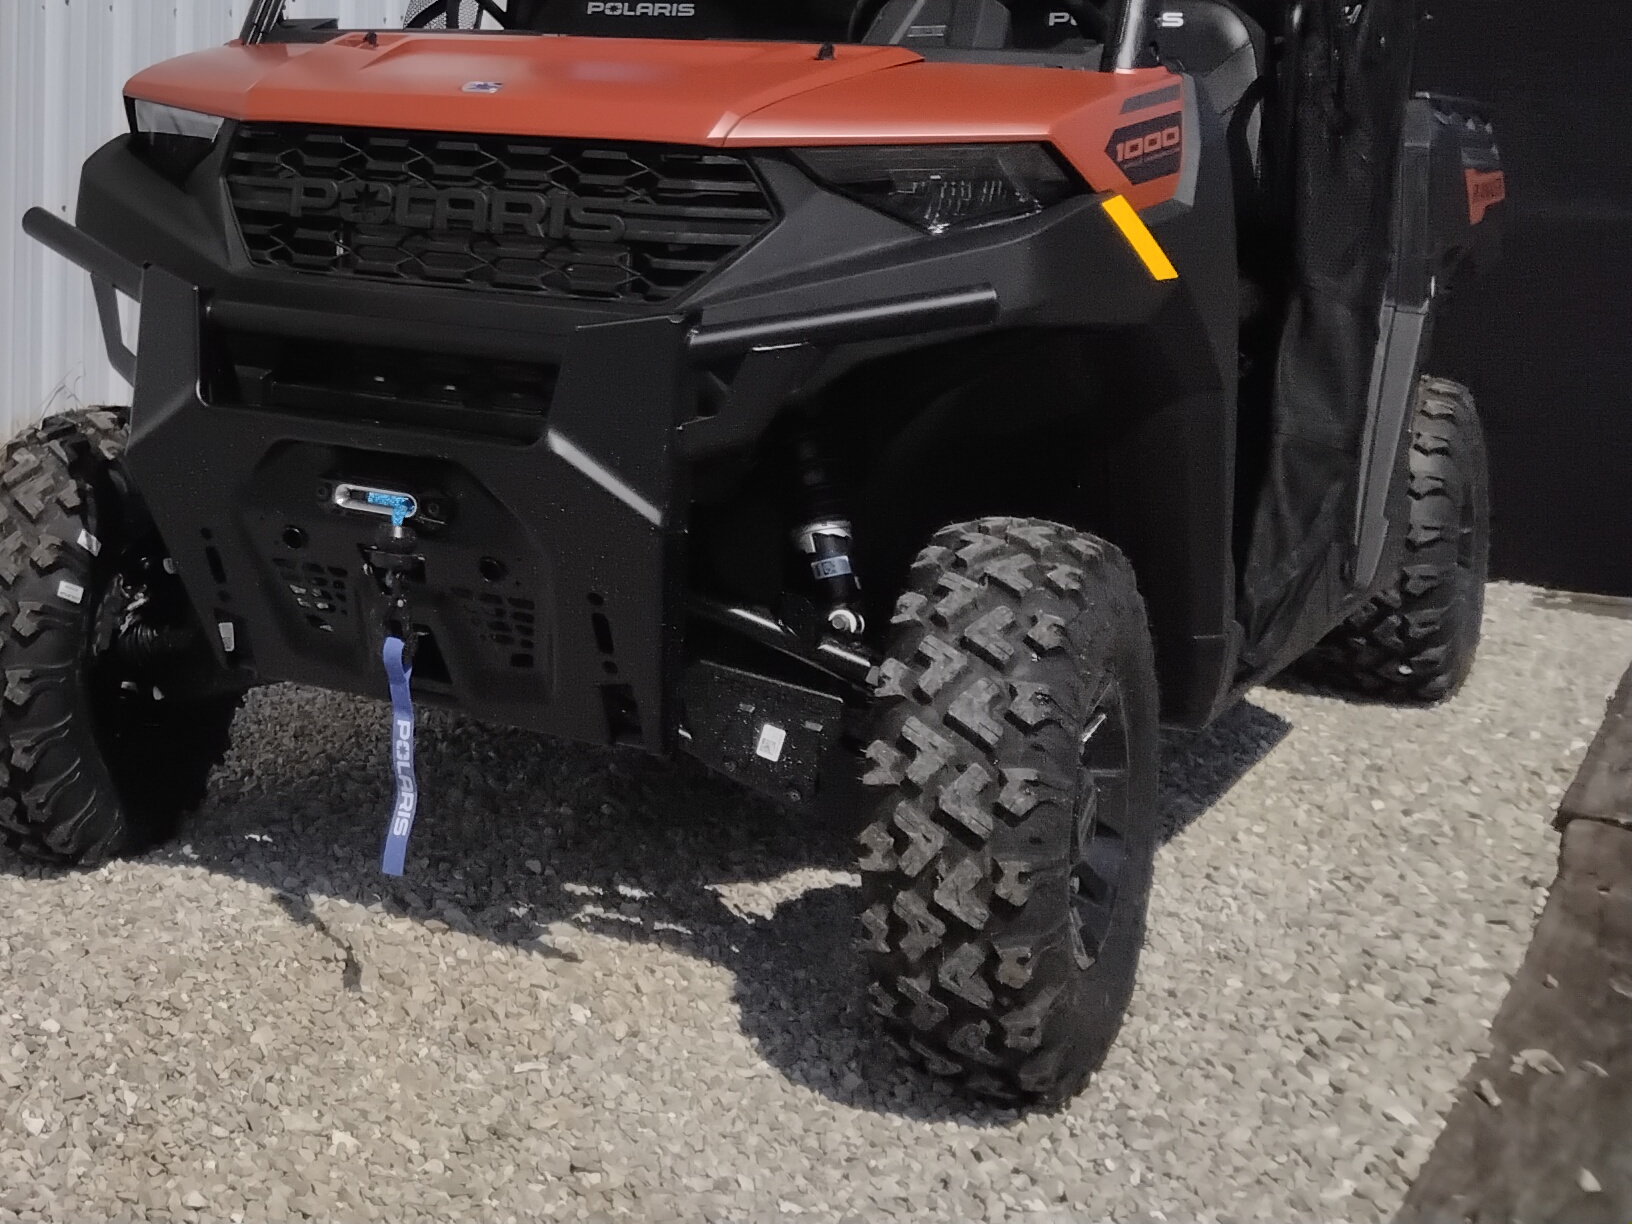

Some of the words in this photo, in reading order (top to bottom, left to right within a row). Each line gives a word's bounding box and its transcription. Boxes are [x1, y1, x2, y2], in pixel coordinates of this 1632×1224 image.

[586, 1, 696, 17] POLARIS
[1115, 125, 1180, 163] 1000
[288, 177, 626, 243] POLARIS
[393, 719, 415, 836] POLARIS
